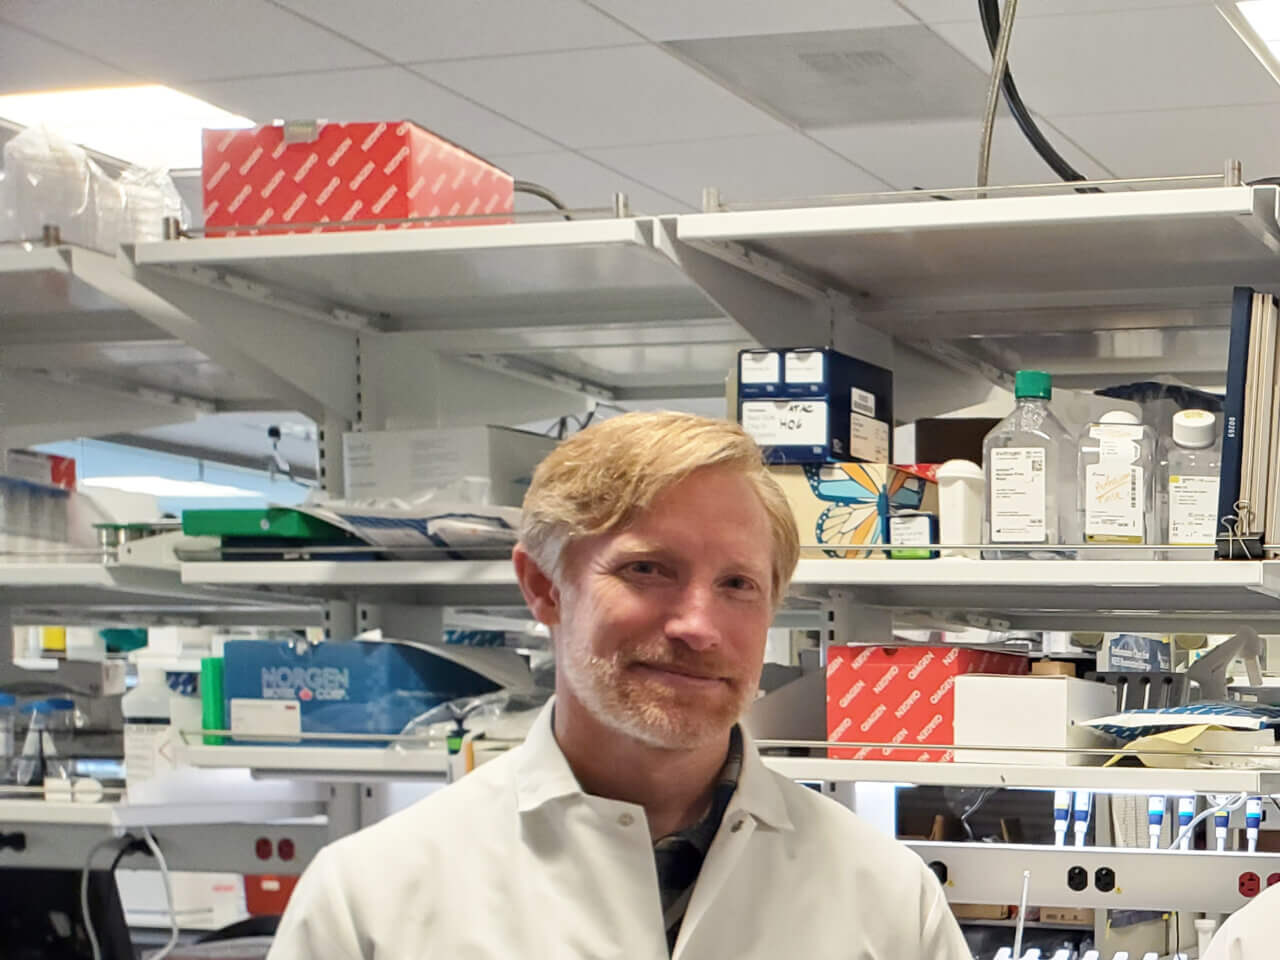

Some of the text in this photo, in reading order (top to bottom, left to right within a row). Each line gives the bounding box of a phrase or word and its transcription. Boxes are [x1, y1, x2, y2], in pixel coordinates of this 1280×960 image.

[261, 667, 350, 689] NORGEN
[873, 665, 899, 694] QIAGEN
[908, 651, 935, 680] QIAGEN
[839, 680, 866, 708] QIAGEN
[895, 690, 921, 719] QIAGEN
[860, 704, 887, 732] QIAGEN
[917, 714, 943, 742] QIAGEN
